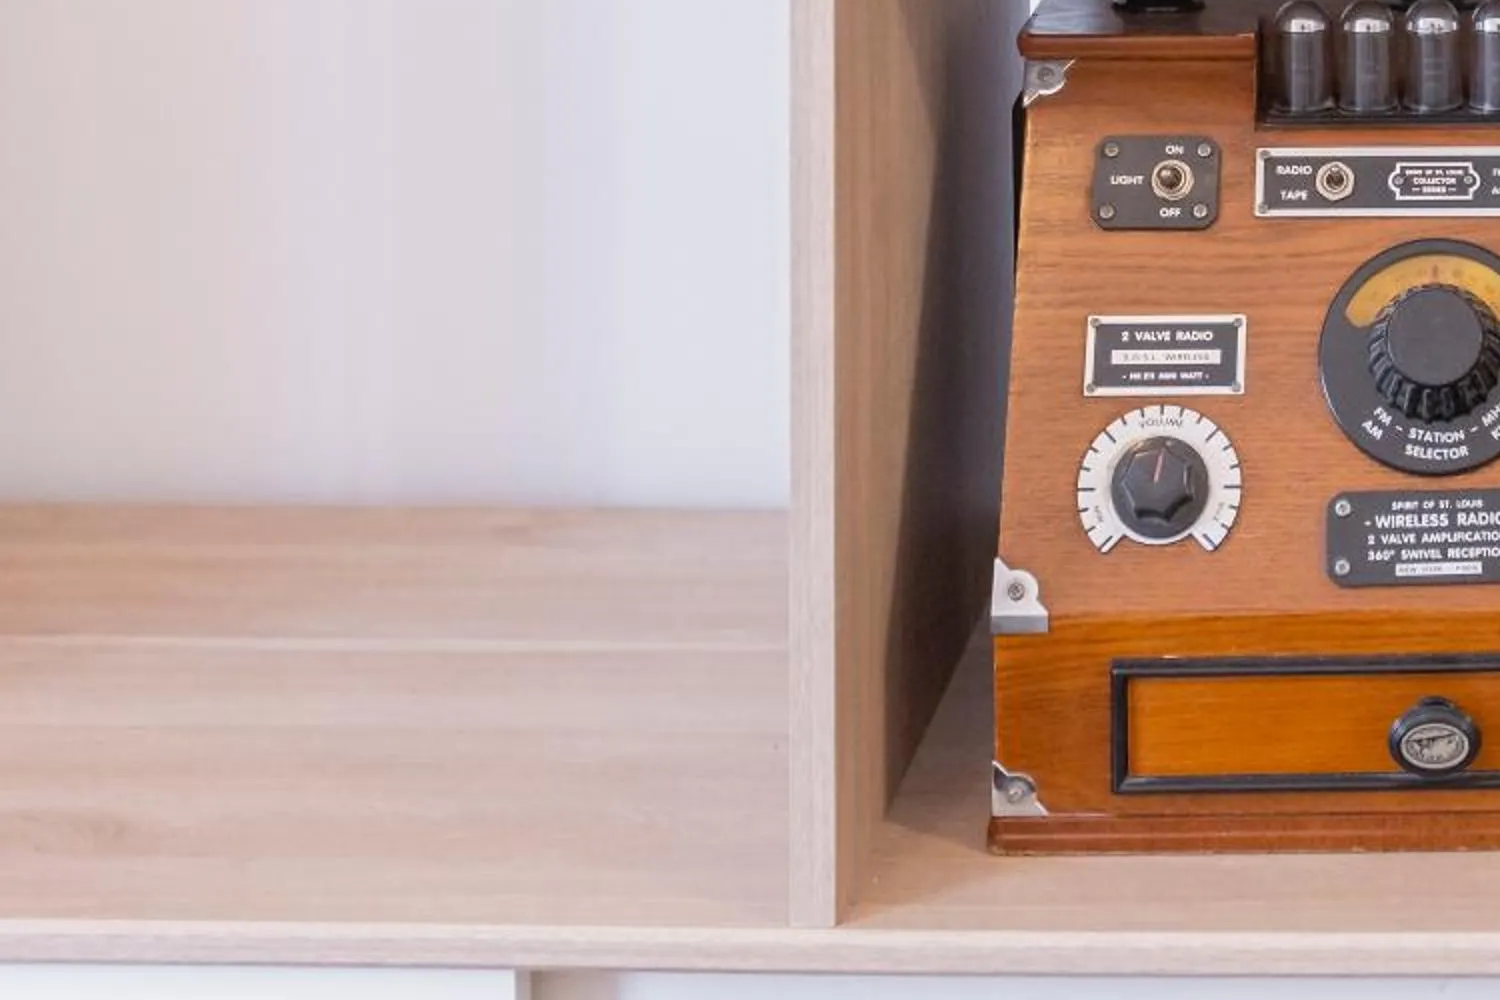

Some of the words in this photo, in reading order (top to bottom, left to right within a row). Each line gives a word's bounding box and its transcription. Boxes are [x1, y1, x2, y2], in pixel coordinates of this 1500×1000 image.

[1165, 144, 1184, 155] ON
[1275, 165, 1312, 175] RADIO
[1110, 174, 1144, 185] LIGHT
[1280, 190, 1308, 200] TAPE
[1159, 207, 1182, 218] OFF
[1121, 331, 1130, 342] 2
[1134, 330, 1171, 341] VALVE
[1176, 330, 1214, 341] RADIO
[1373, 406, 1393, 427] FM
[1407, 427, 1466, 444] STATION
[1361, 419, 1384, 441] AM
[1404, 443, 1470, 461] SELECTOR
[1456, 499, 1483, 509] LOUIS
[1367, 534, 1376, 545] 2
[1380, 532, 1417, 545] VALVE
[1401, 549, 1443, 560] SWIVEL
